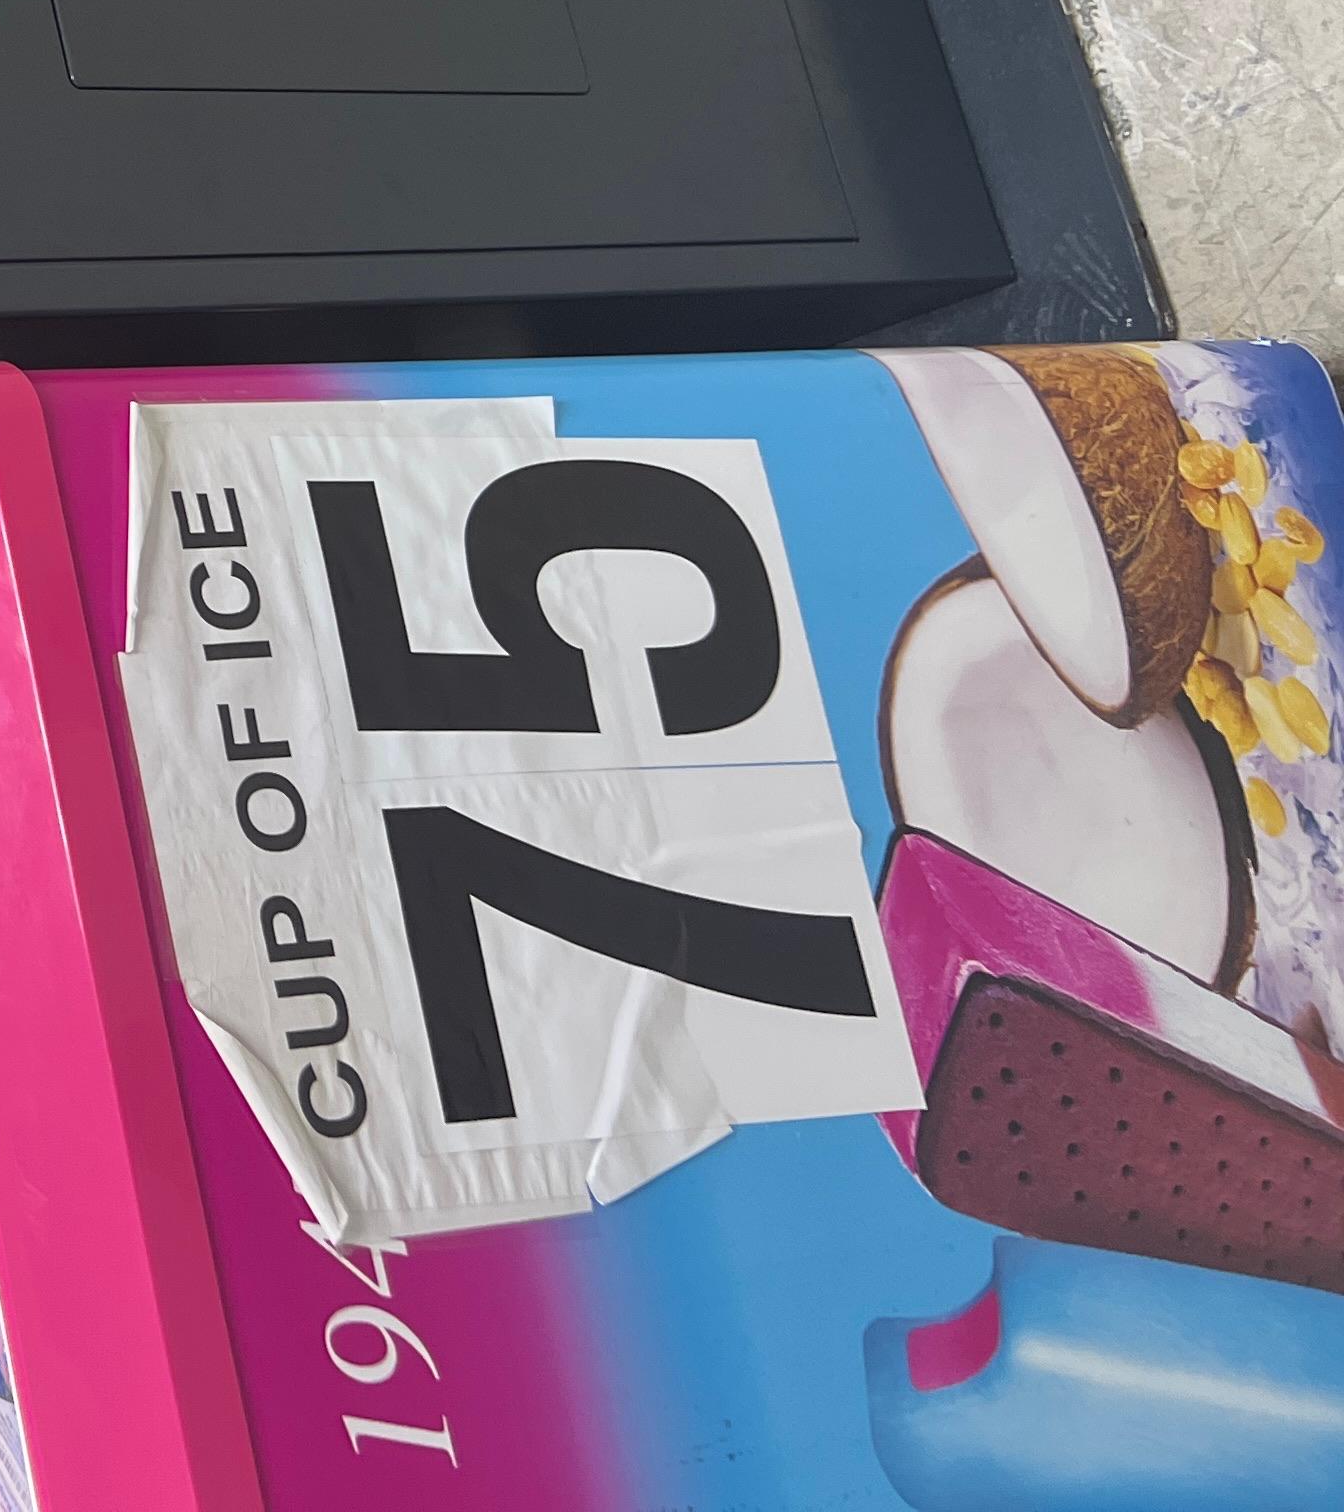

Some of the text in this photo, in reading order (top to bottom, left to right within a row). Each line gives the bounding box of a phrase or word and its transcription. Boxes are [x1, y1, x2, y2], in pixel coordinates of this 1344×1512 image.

[170, 486, 368, 1139] CUP OF ICE
[306, 456, 878, 1125] 75
